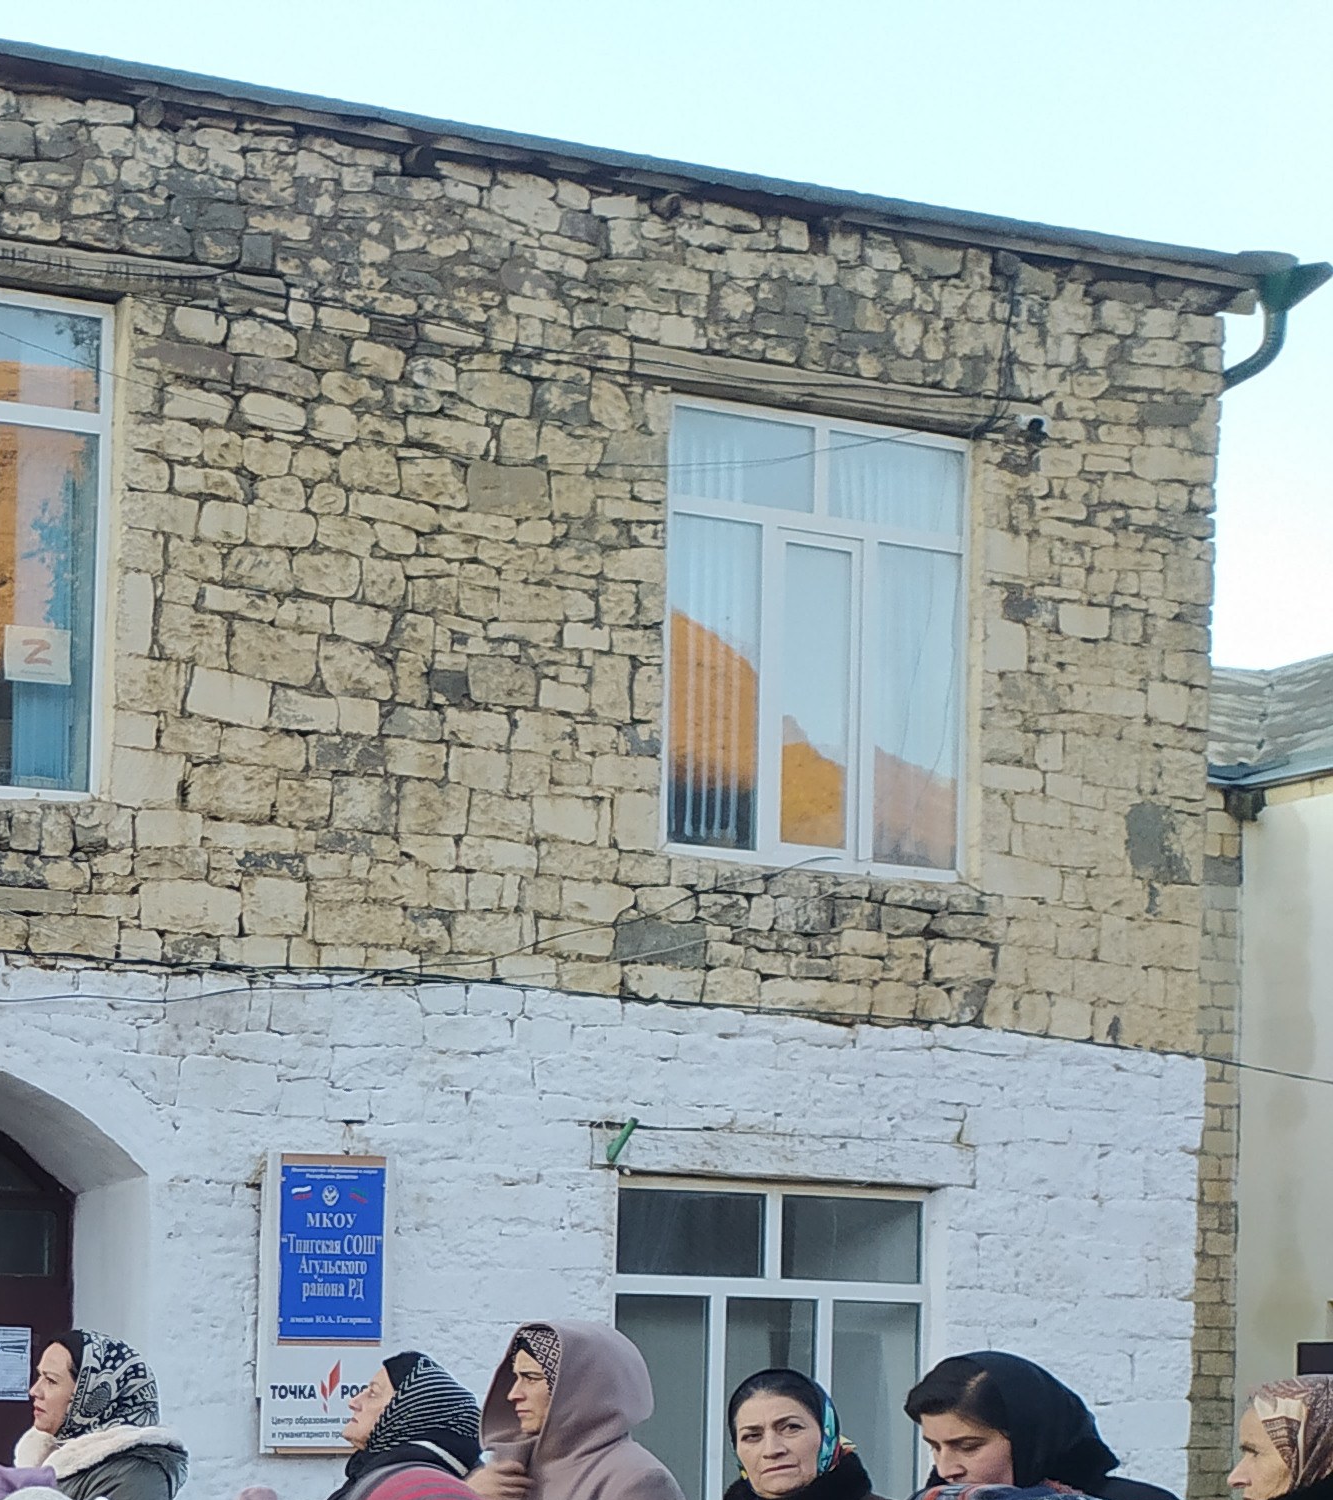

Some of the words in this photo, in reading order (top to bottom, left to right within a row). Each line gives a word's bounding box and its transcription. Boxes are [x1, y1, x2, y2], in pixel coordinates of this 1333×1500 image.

[306, 1212, 357, 1229] МКОУ
[297, 1255, 368, 1279] Агульского
[302, 1277, 345, 1302] района
[347, 1278, 365, 1300] РД
[270, 1385, 317, 1399] ТОЧКА
[271, 1416, 293, 1425] Центр
[295, 1416, 340, 1425] образования
